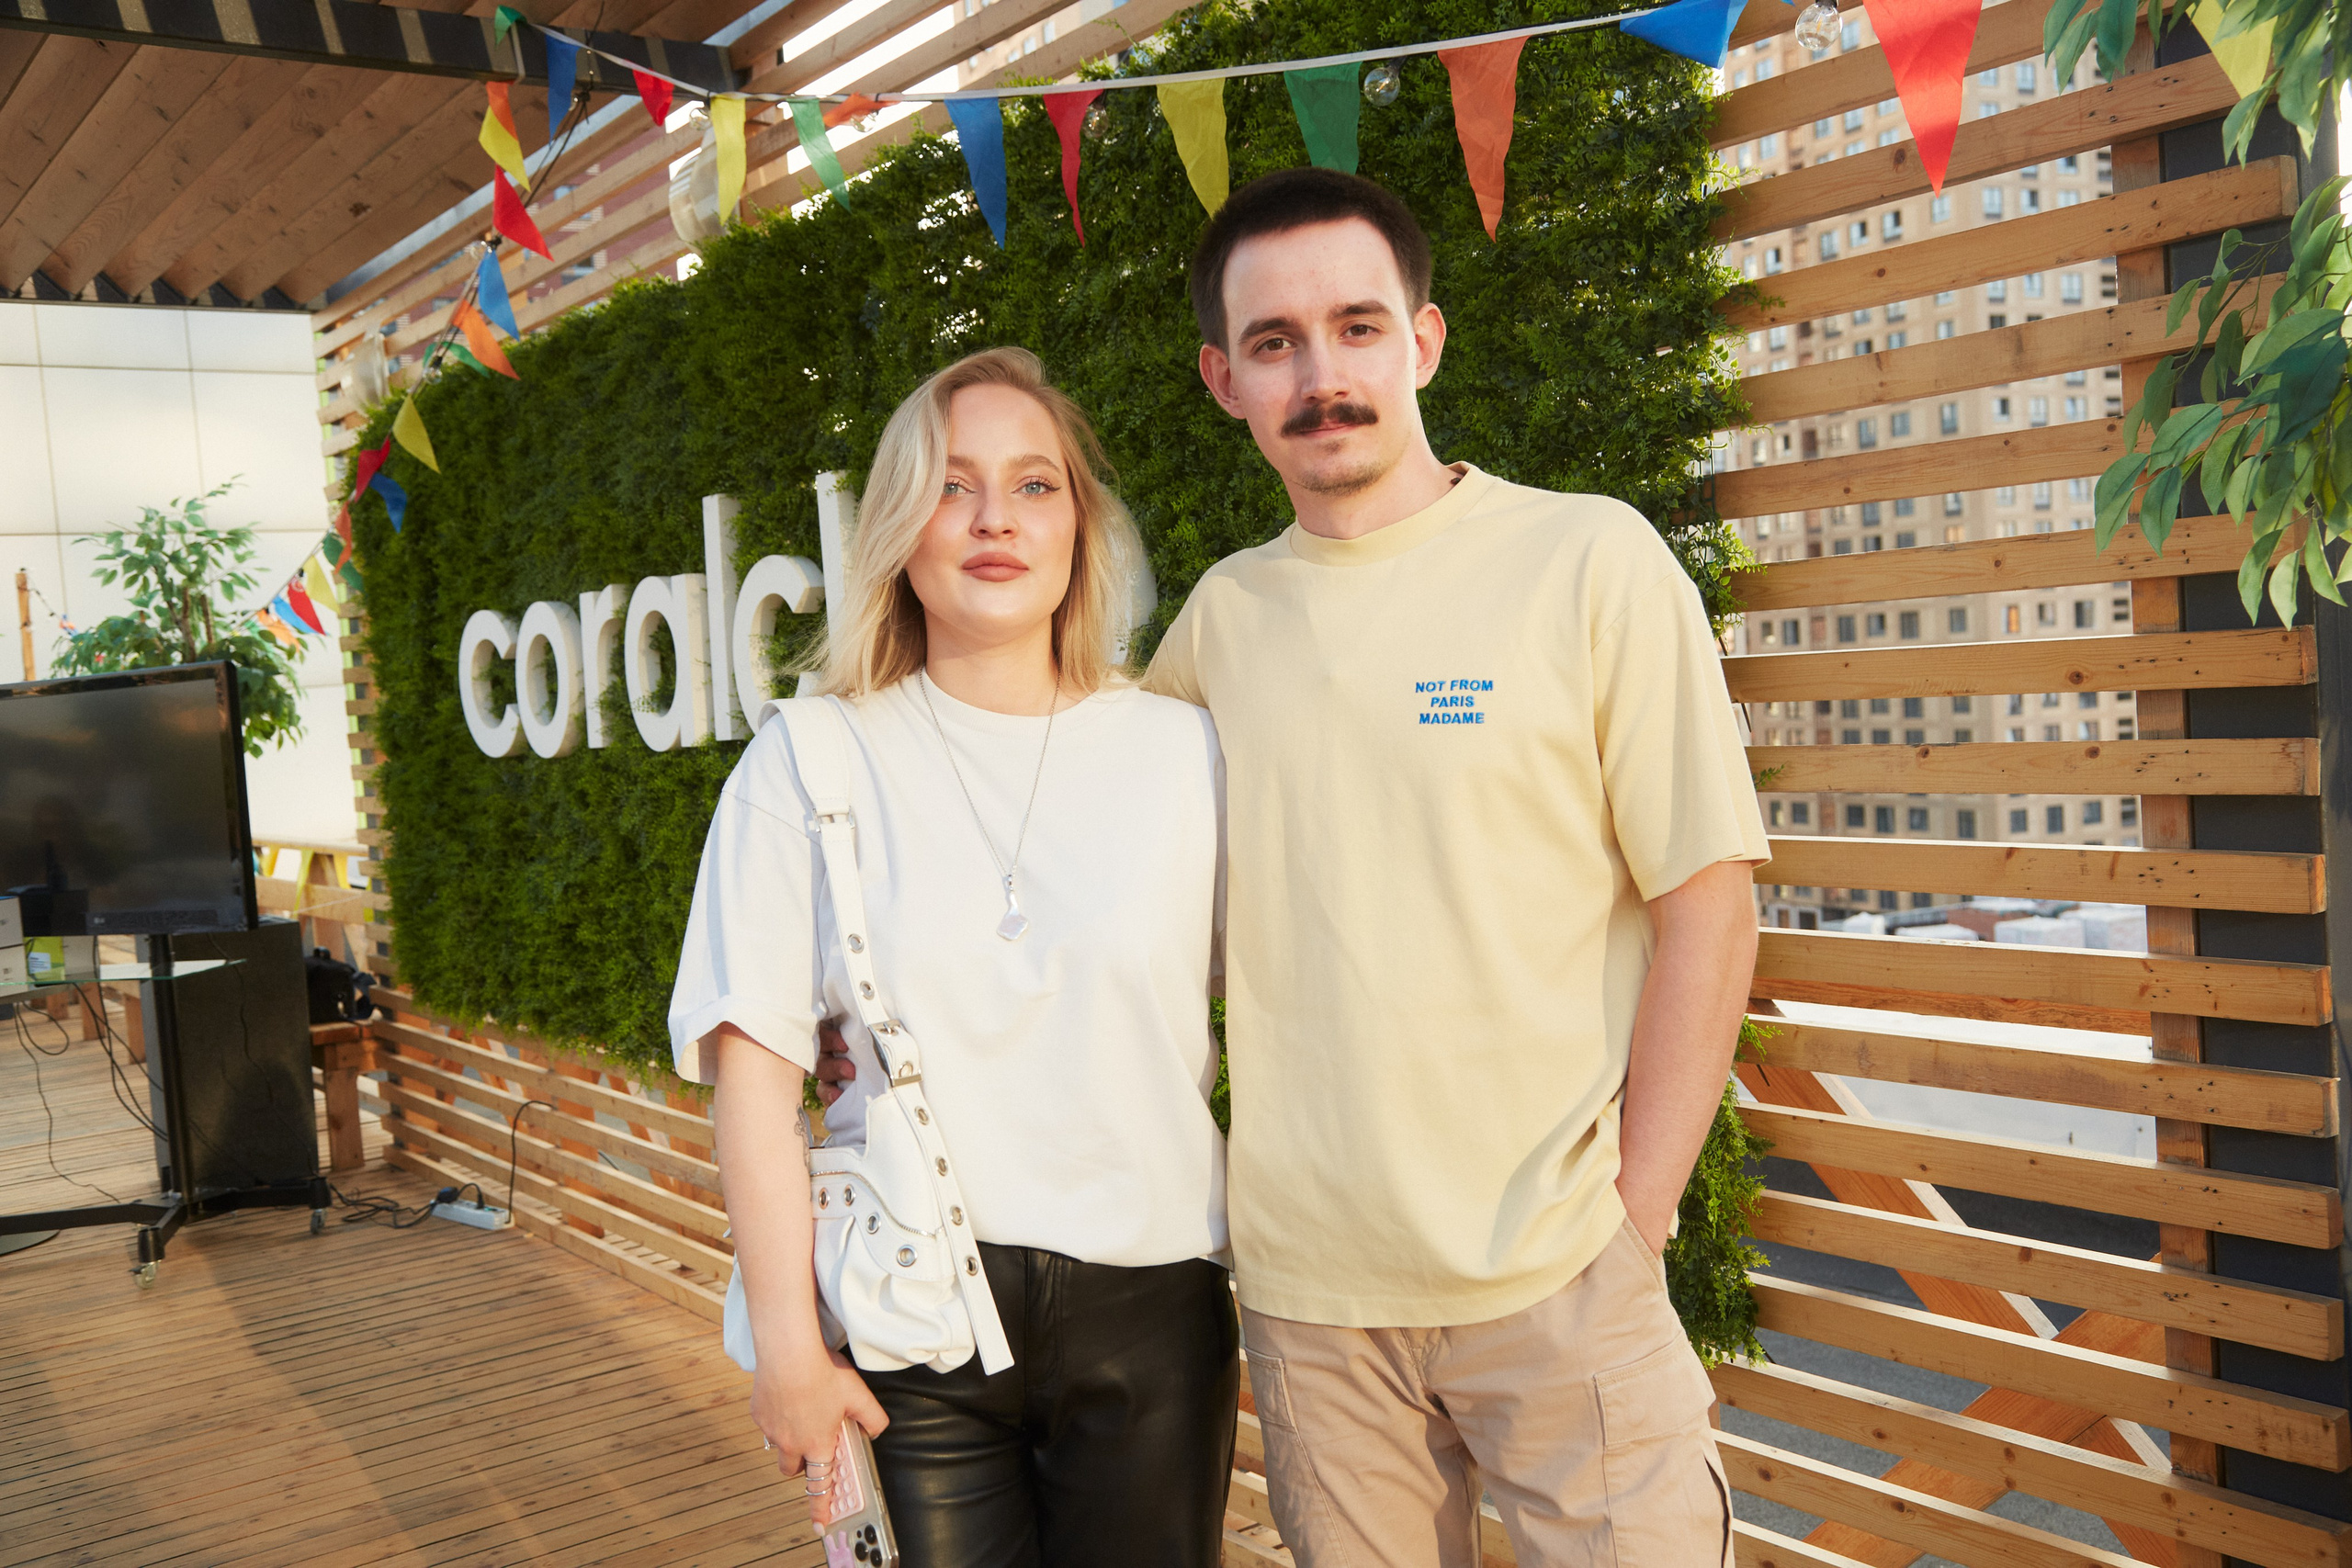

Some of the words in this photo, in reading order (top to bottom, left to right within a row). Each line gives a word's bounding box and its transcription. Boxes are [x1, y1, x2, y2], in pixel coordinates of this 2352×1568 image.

[1416, 681, 1446, 693] NOT
[1450, 679, 1493, 692] FROM
[1430, 695, 1475, 707] PARIS
[1419, 712, 1485, 724] MADAME
